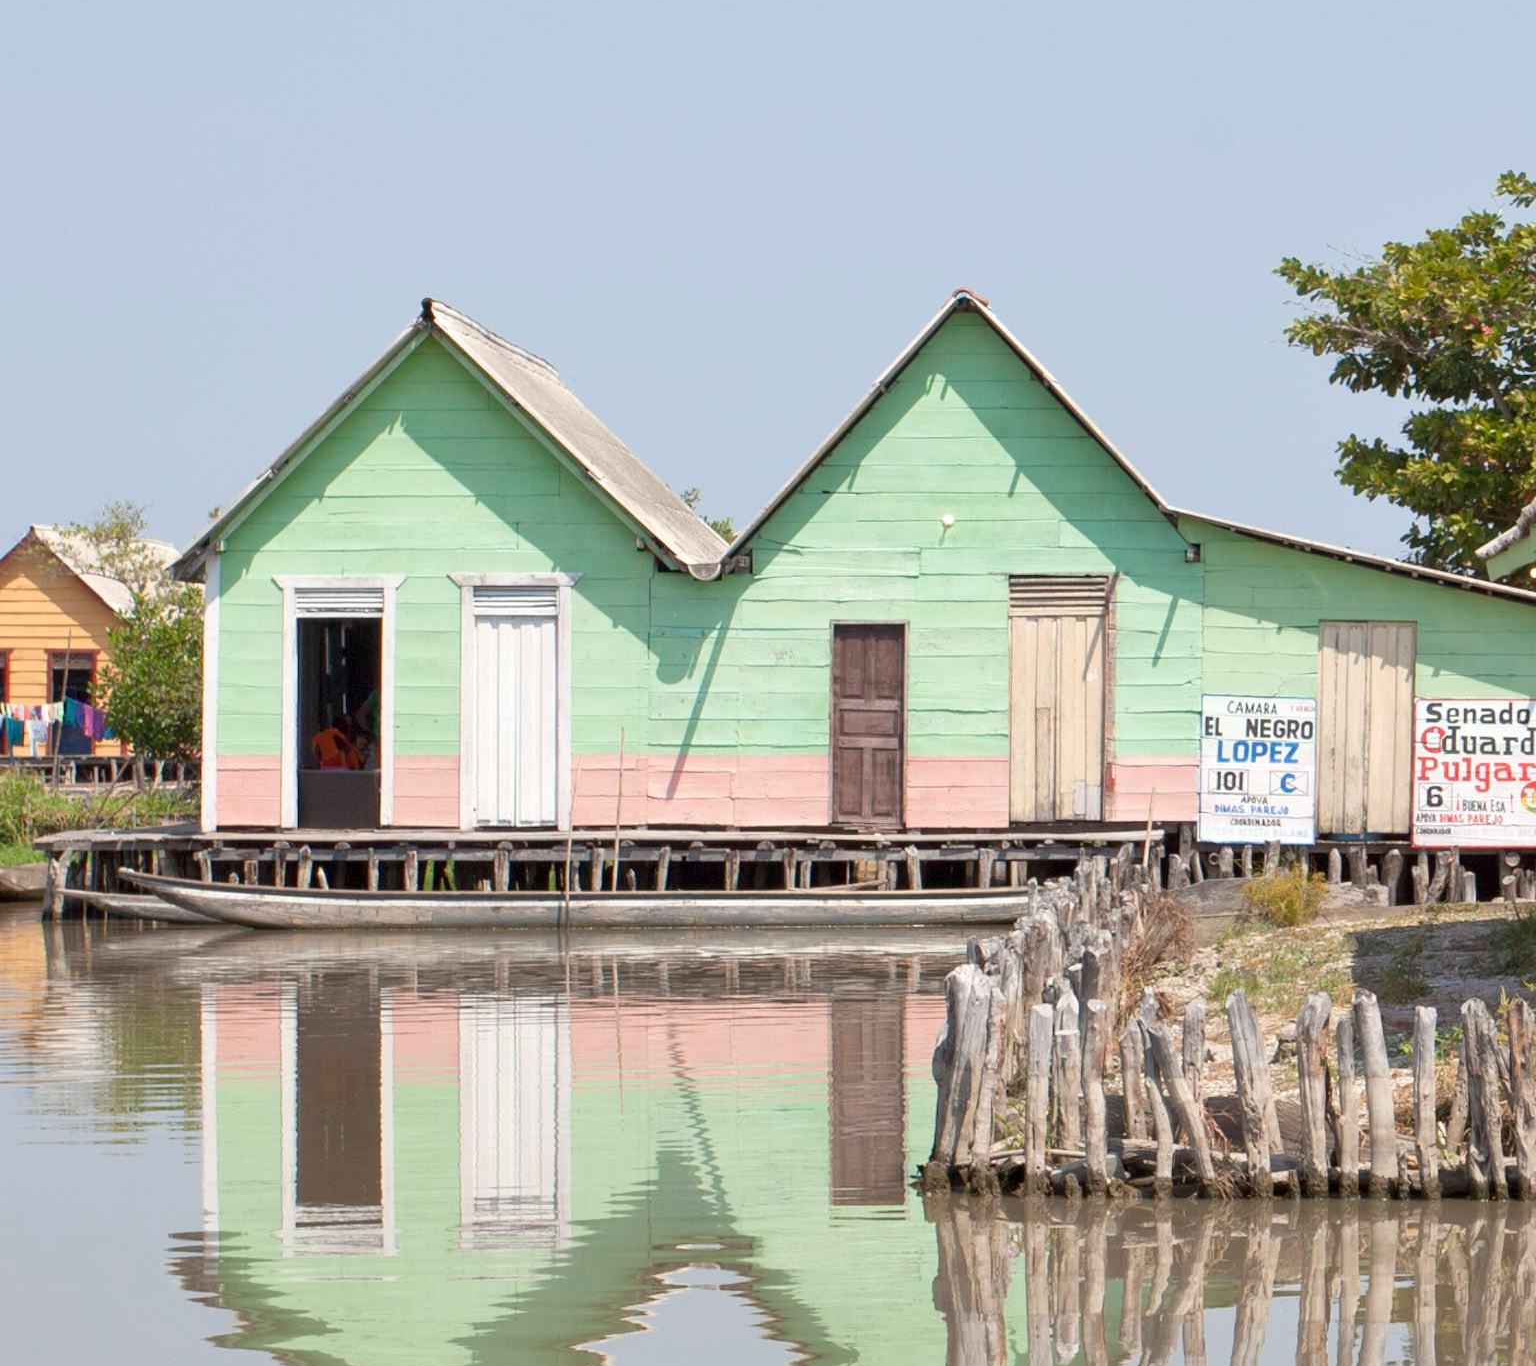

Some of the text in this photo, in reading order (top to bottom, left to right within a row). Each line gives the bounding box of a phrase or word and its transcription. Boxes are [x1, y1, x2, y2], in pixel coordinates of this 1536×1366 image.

[1227, 701, 1278, 715] CAMARA
[1426, 702, 1530, 725] Senado
[1205, 717, 1313, 739] EL NEGRO
[1217, 740, 1299, 763] LOPEZ
[1216, 771, 1297, 793] 101 C
[1417, 757, 1536, 793] Pulgar
[1426, 786, 1443, 807] 6
[1214, 804, 1289, 815] DIMAS PAREJO
[1439, 814, 1464, 823] DIMAS
[1467, 814, 1503, 825] PAREJO
